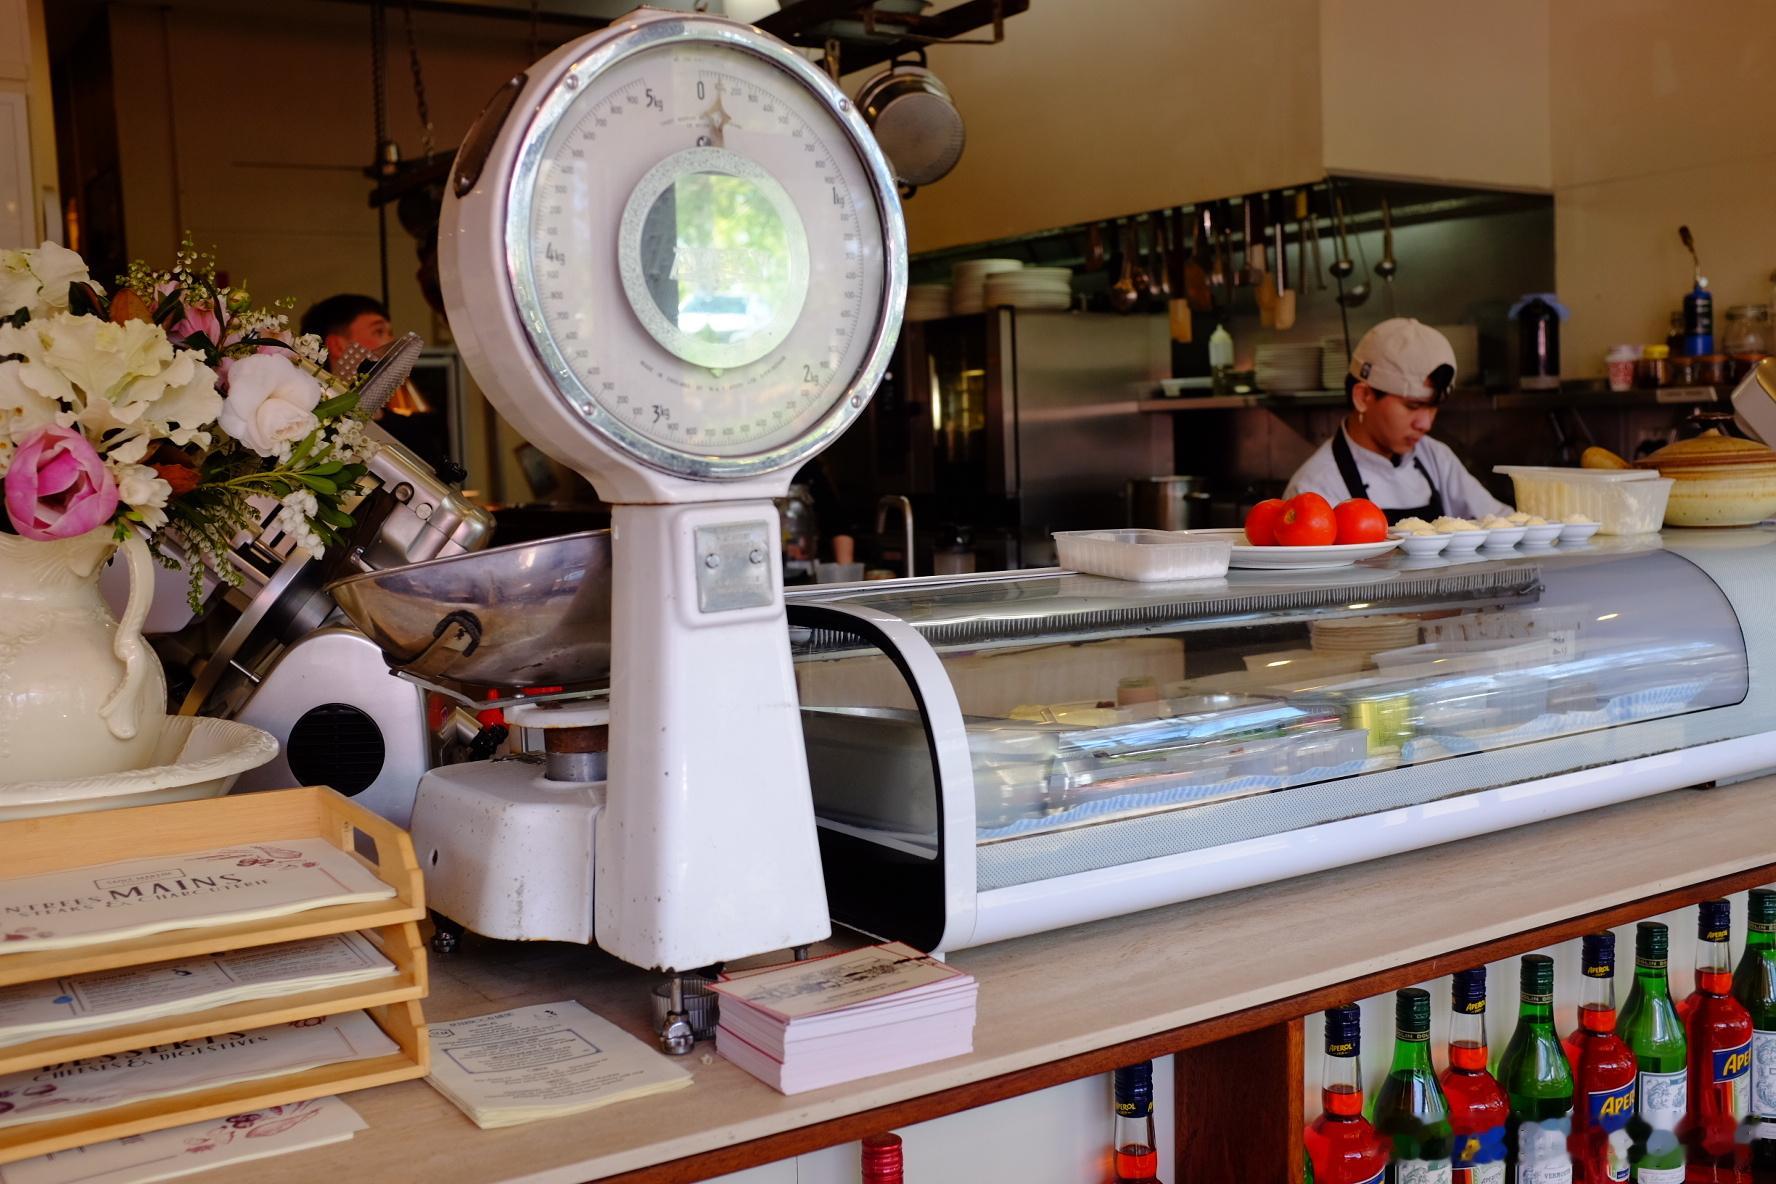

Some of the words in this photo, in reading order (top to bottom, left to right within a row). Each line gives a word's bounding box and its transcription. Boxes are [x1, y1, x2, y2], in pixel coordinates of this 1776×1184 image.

[645, 88, 664, 112] 5kg
[695, 79, 706, 101] 0
[832, 186, 845, 208] 1kg
[545, 242, 566, 266] 4kg
[802, 364, 819, 386] 2kg
[651, 404, 671, 424] 3kg
[109, 873, 244, 900] MAINS
[138, 878, 270, 903] CHARCUTERIE
[1587, 965, 1610, 975] APEROL
[1329, 1043, 1353, 1052] APEROL
[33, 1062, 122, 1082] CHEESES
[160, 1036, 268, 1061] DIGESTIVES
